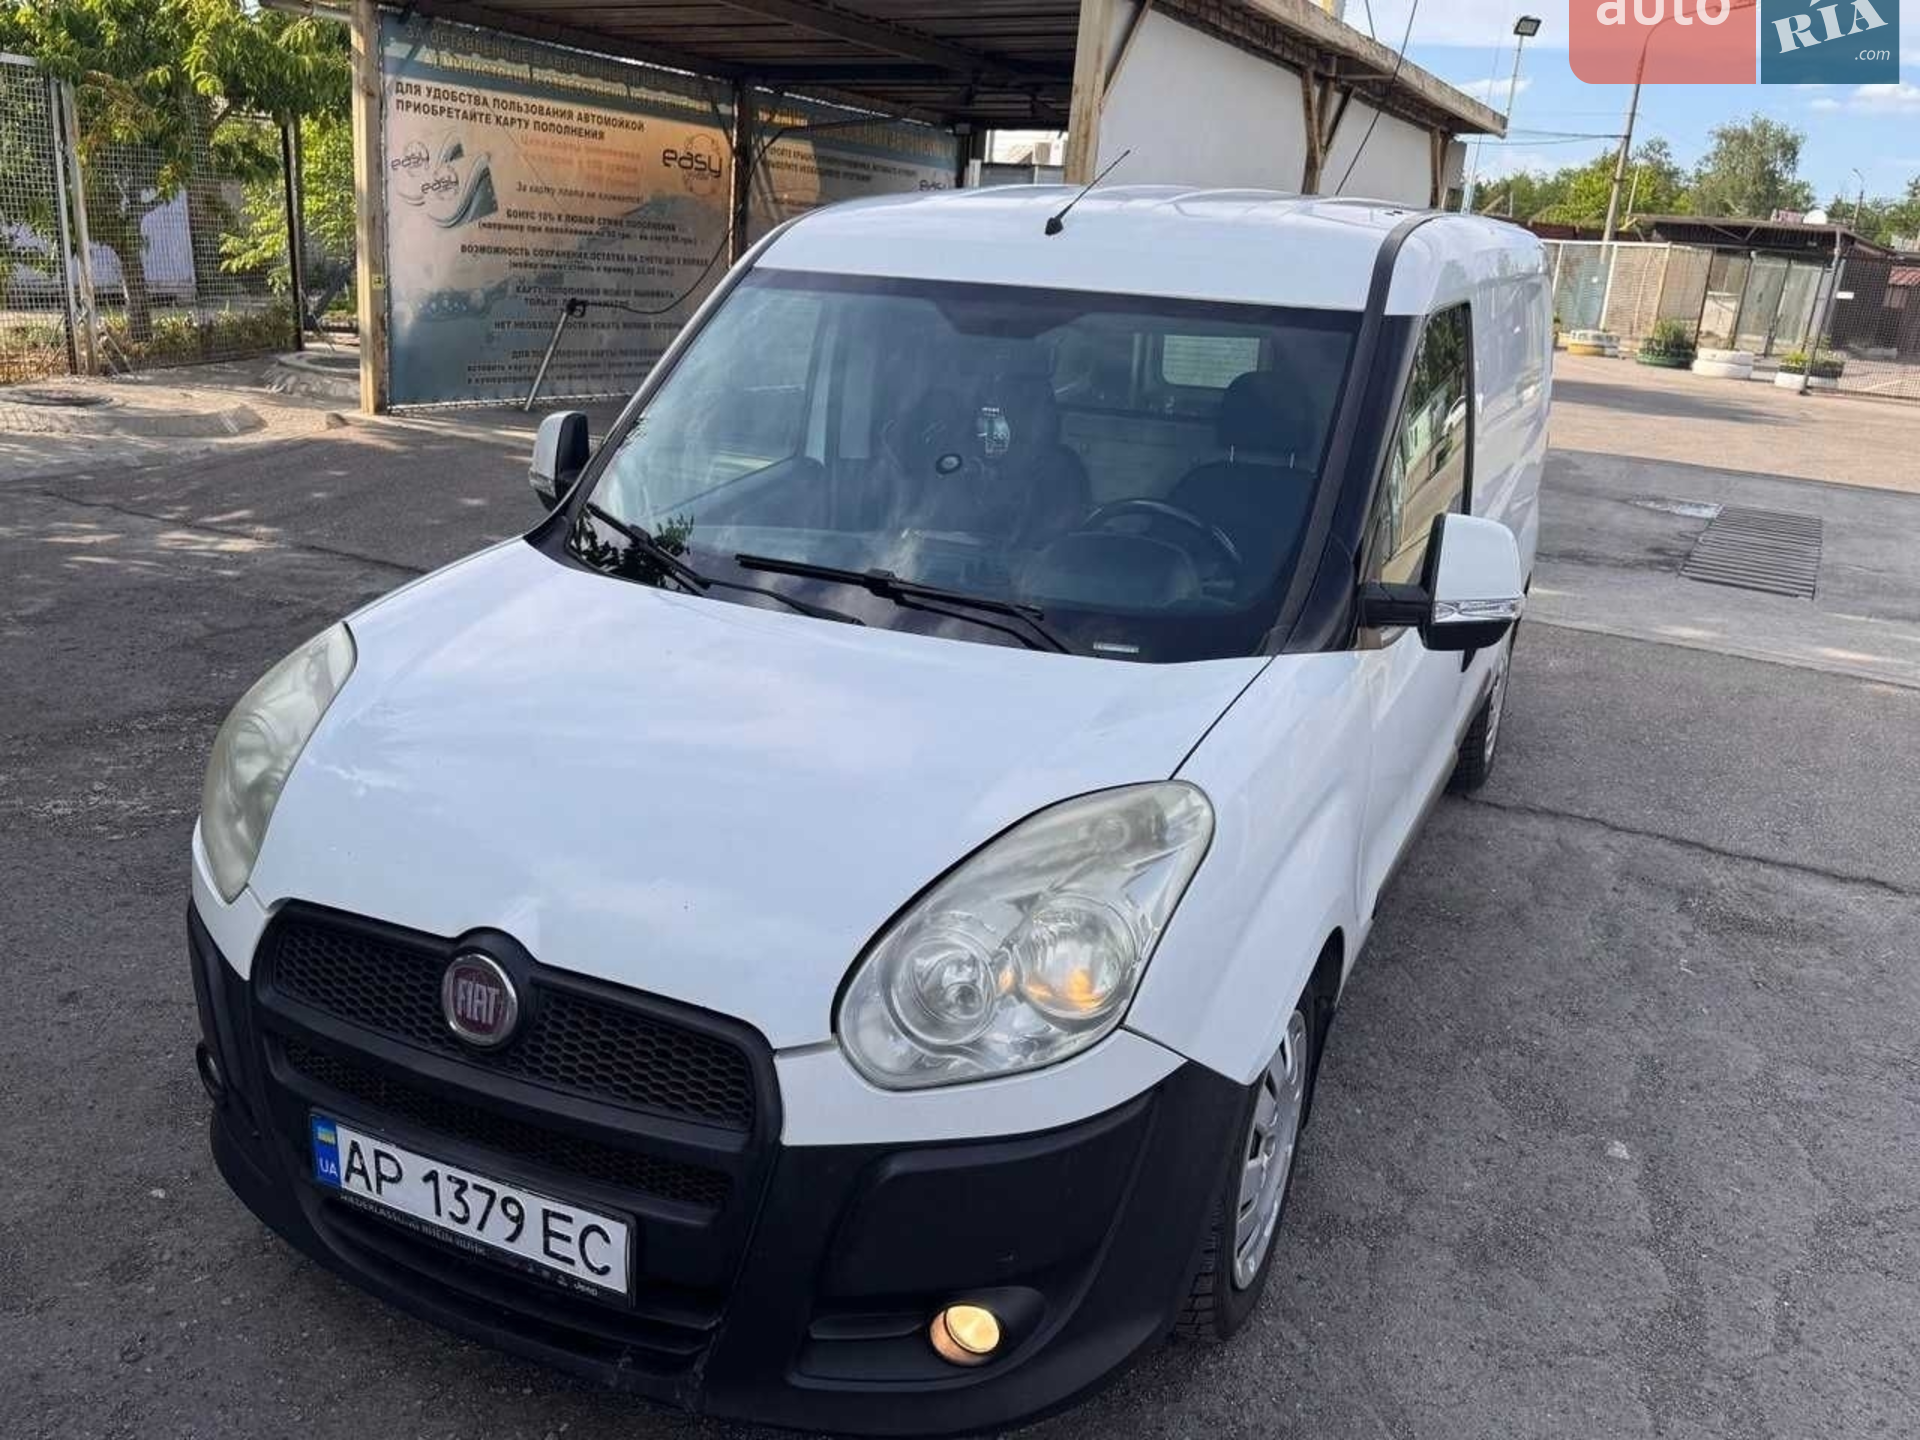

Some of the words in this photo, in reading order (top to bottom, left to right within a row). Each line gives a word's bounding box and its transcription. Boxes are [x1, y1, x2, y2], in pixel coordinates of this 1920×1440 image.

[394, 81, 421, 97] ДЛЯ
[425, 86, 488, 107] УДОБСТВА
[492, 97, 574, 121] ПОЛЬЗОВАНИЯ
[576, 112, 645, 133] АВТОМОЙКОЙ
[395, 97, 491, 125] ПРИОБРЕТАЙТЕ
[495, 115, 529, 130] КАРТУ
[533, 121, 605, 141] ПОПОЛНЕНИЯ
[391, 151, 430, 171] easy
[662, 148, 723, 178] easy
[421, 175, 459, 195] easy
[319, 1158, 339, 1178] UA
[344, 1140, 403, 1195] AP
[421, 1169, 526, 1243] 1379
[541, 1208, 612, 1276] EC
